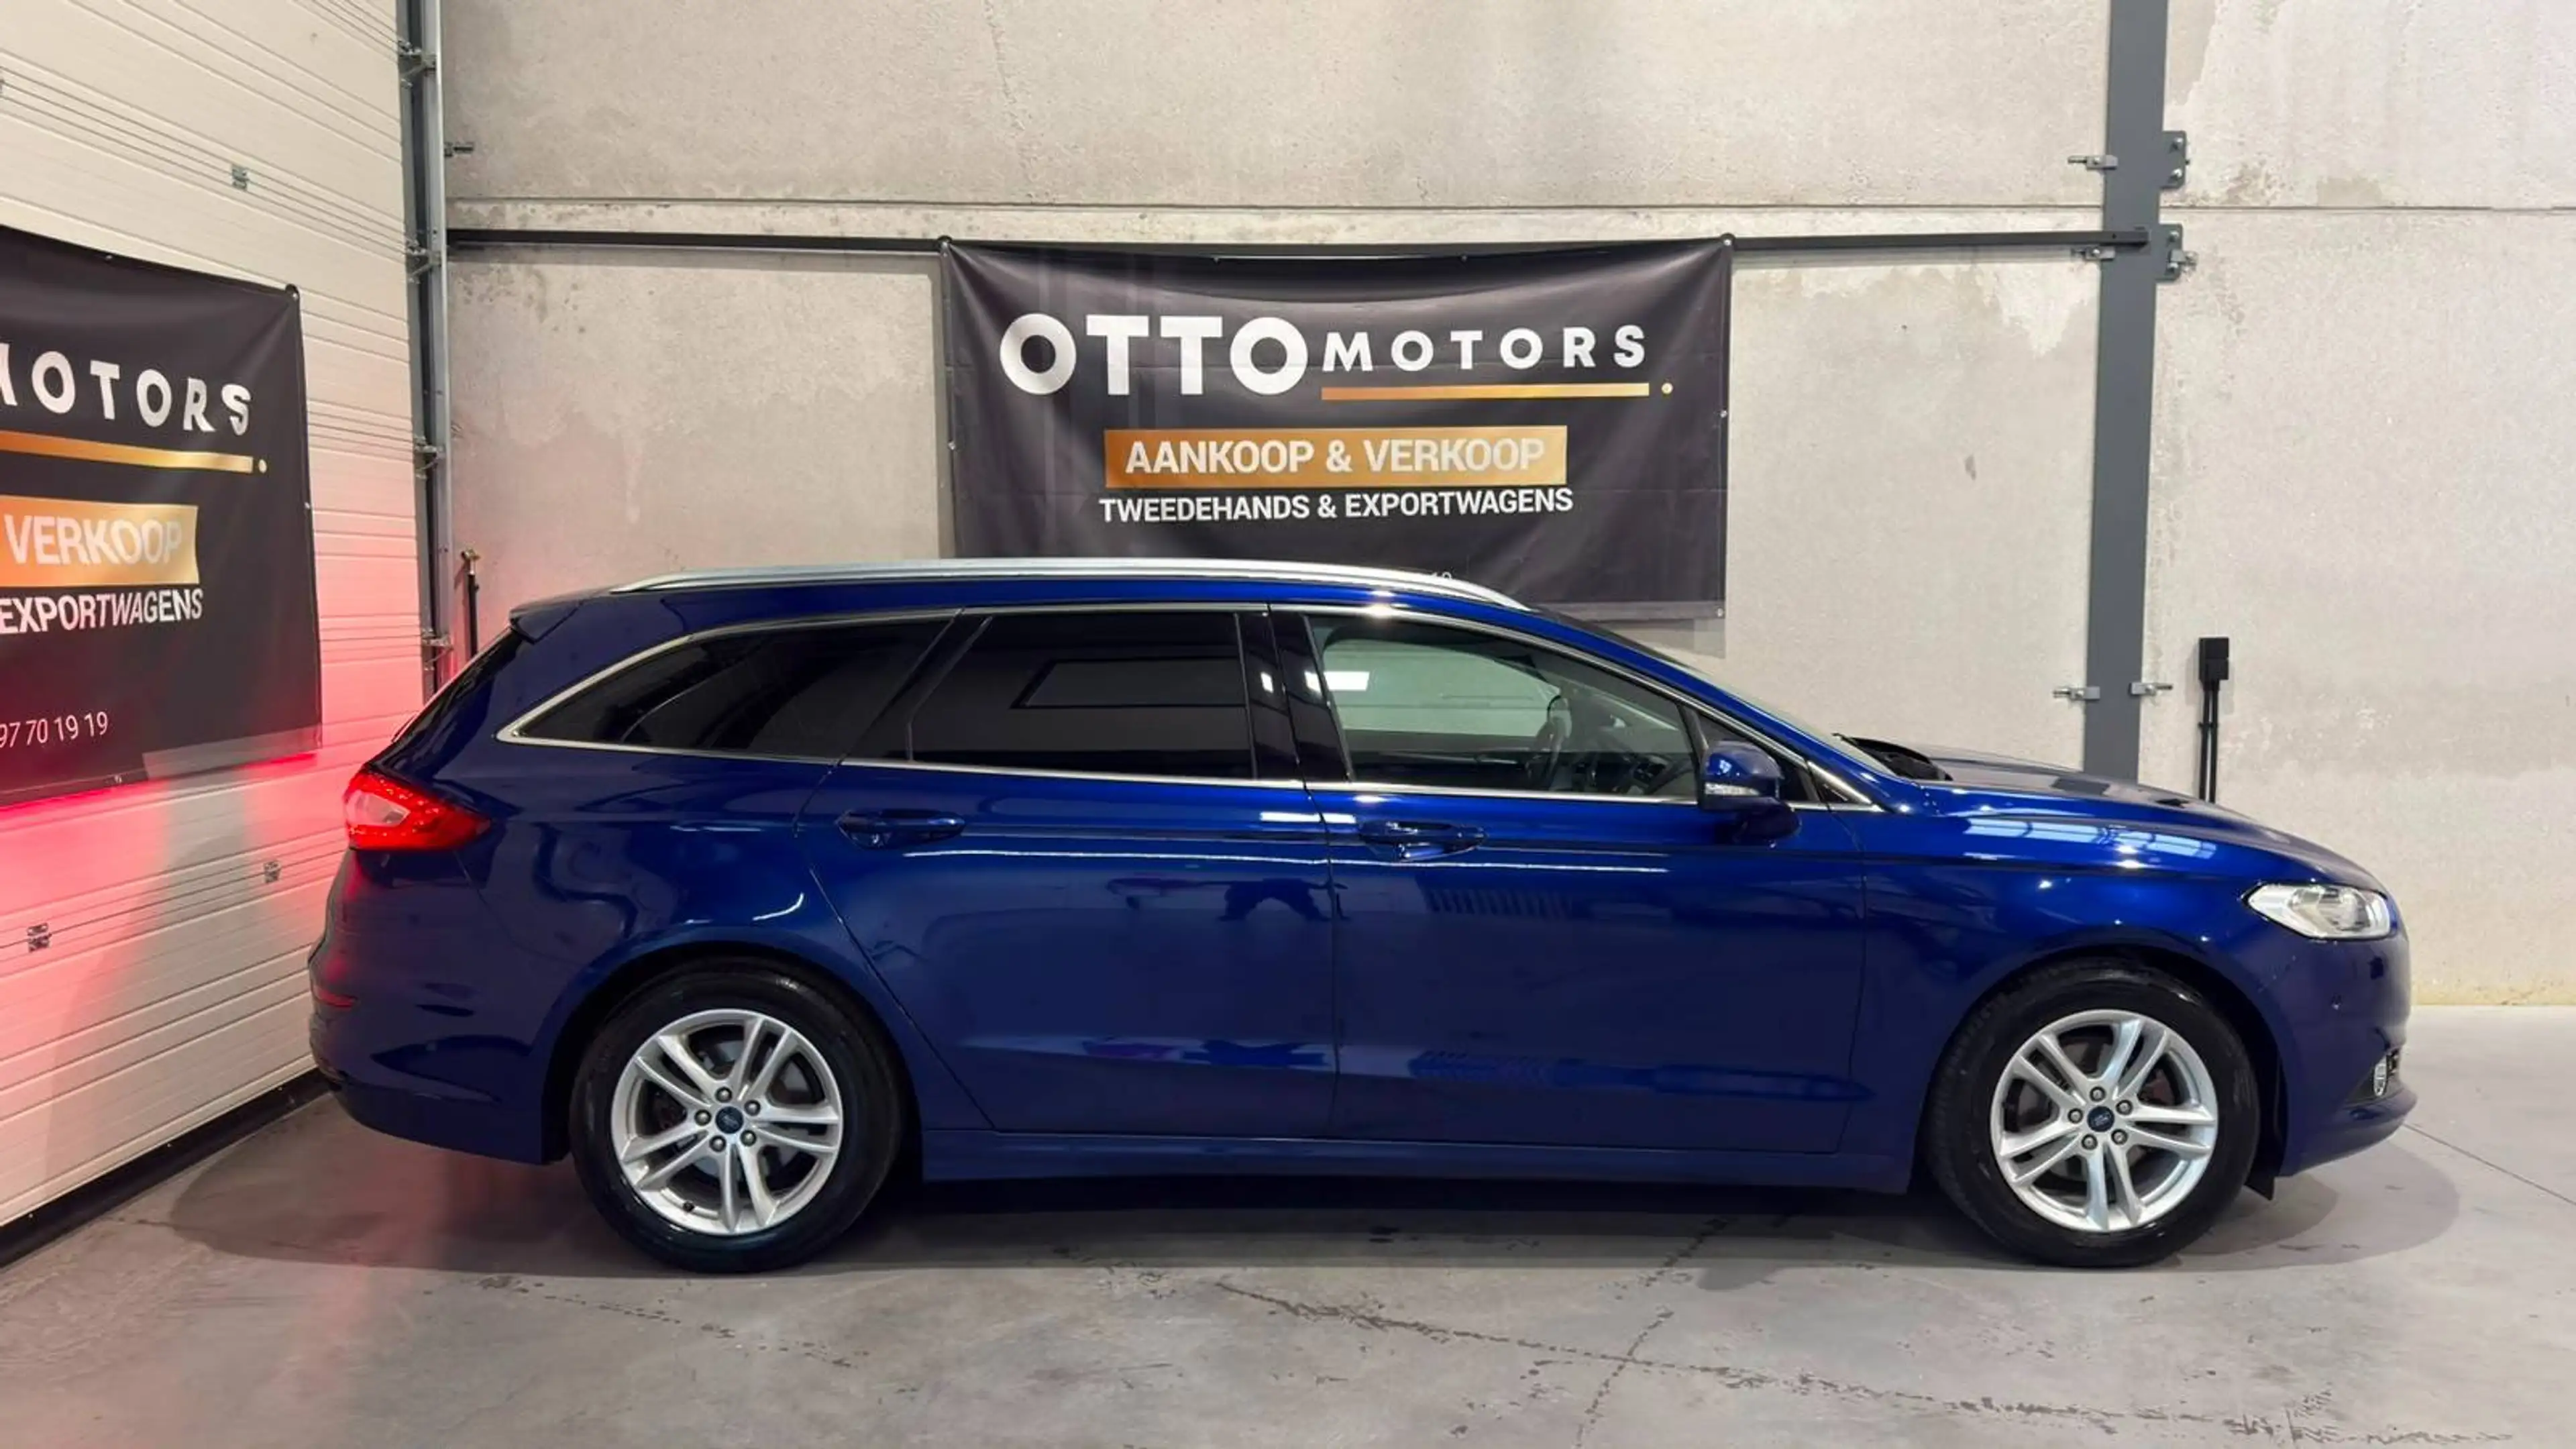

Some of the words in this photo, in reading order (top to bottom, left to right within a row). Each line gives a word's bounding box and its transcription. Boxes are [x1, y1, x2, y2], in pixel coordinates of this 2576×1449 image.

[1000, 313, 1308, 395] OTTO
[1322, 325, 1645, 372] MOTORS
[1125, 440, 1315, 474] AANKOOP
[1326, 440, 1353, 472] &
[1363, 438, 1544, 472] VERKOOP
[1099, 495, 1309, 523] TWEEDEHANDS
[1318, 496, 1338, 518] &
[1345, 488, 1573, 517] EXPORTWAGENS
[3, 514, 182, 565] VERKOOP
[0, 588, 204, 635] EXPORTWAGENS
[25, 718, 48, 746] 70
[54, 714, 79, 741] 19
[84, 711, 109, 737] 19
